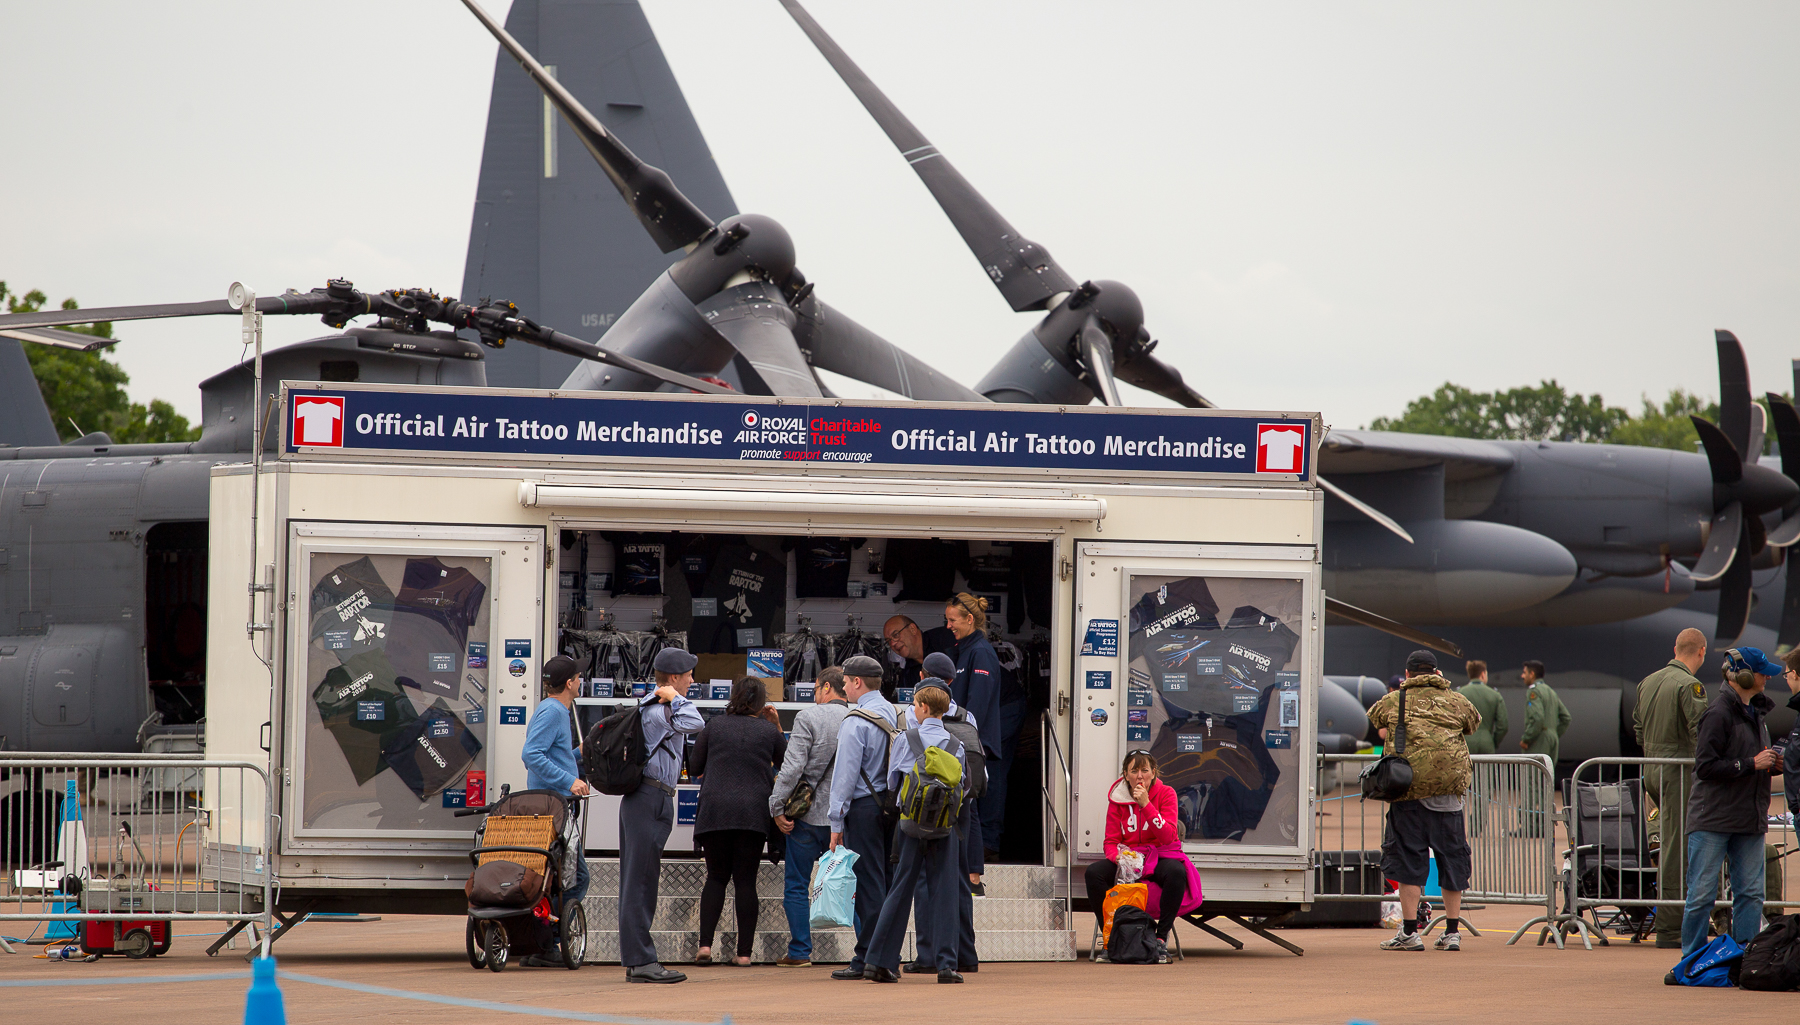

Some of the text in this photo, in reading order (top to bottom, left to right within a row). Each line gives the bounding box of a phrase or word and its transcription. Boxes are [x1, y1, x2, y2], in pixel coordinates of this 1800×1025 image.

[581, 313, 615, 327] USAF
[355, 413, 723, 445] Official Air Tattoo Merchandise
[761, 417, 807, 430] ROYAL
[810, 418, 881, 433] Charitable
[733, 430, 806, 444] AIR FORCE
[810, 433, 847, 445] Trust
[891, 429, 1246, 459] Official Air Tattoo Merchandise
[740, 449, 873, 463] promote support encourage
[623, 545, 660, 554] AIR TATTO
[729, 575, 762, 593] RAPTOR
[335, 597, 352, 612] RETURN
[355, 588, 366, 598] THE
[338, 595, 372, 622] RAPTOR
[1145, 606, 1197, 638] AIR TATTOO
[1183, 613, 1200, 626] 2016
[1228, 645, 1271, 666] AIR TATTOO
[1255, 663, 1269, 673] 2016
[339, 673, 374, 699] AIR TATTOO
[417, 736, 429, 749] AIR
[427, 746, 446, 768] TATTOO
